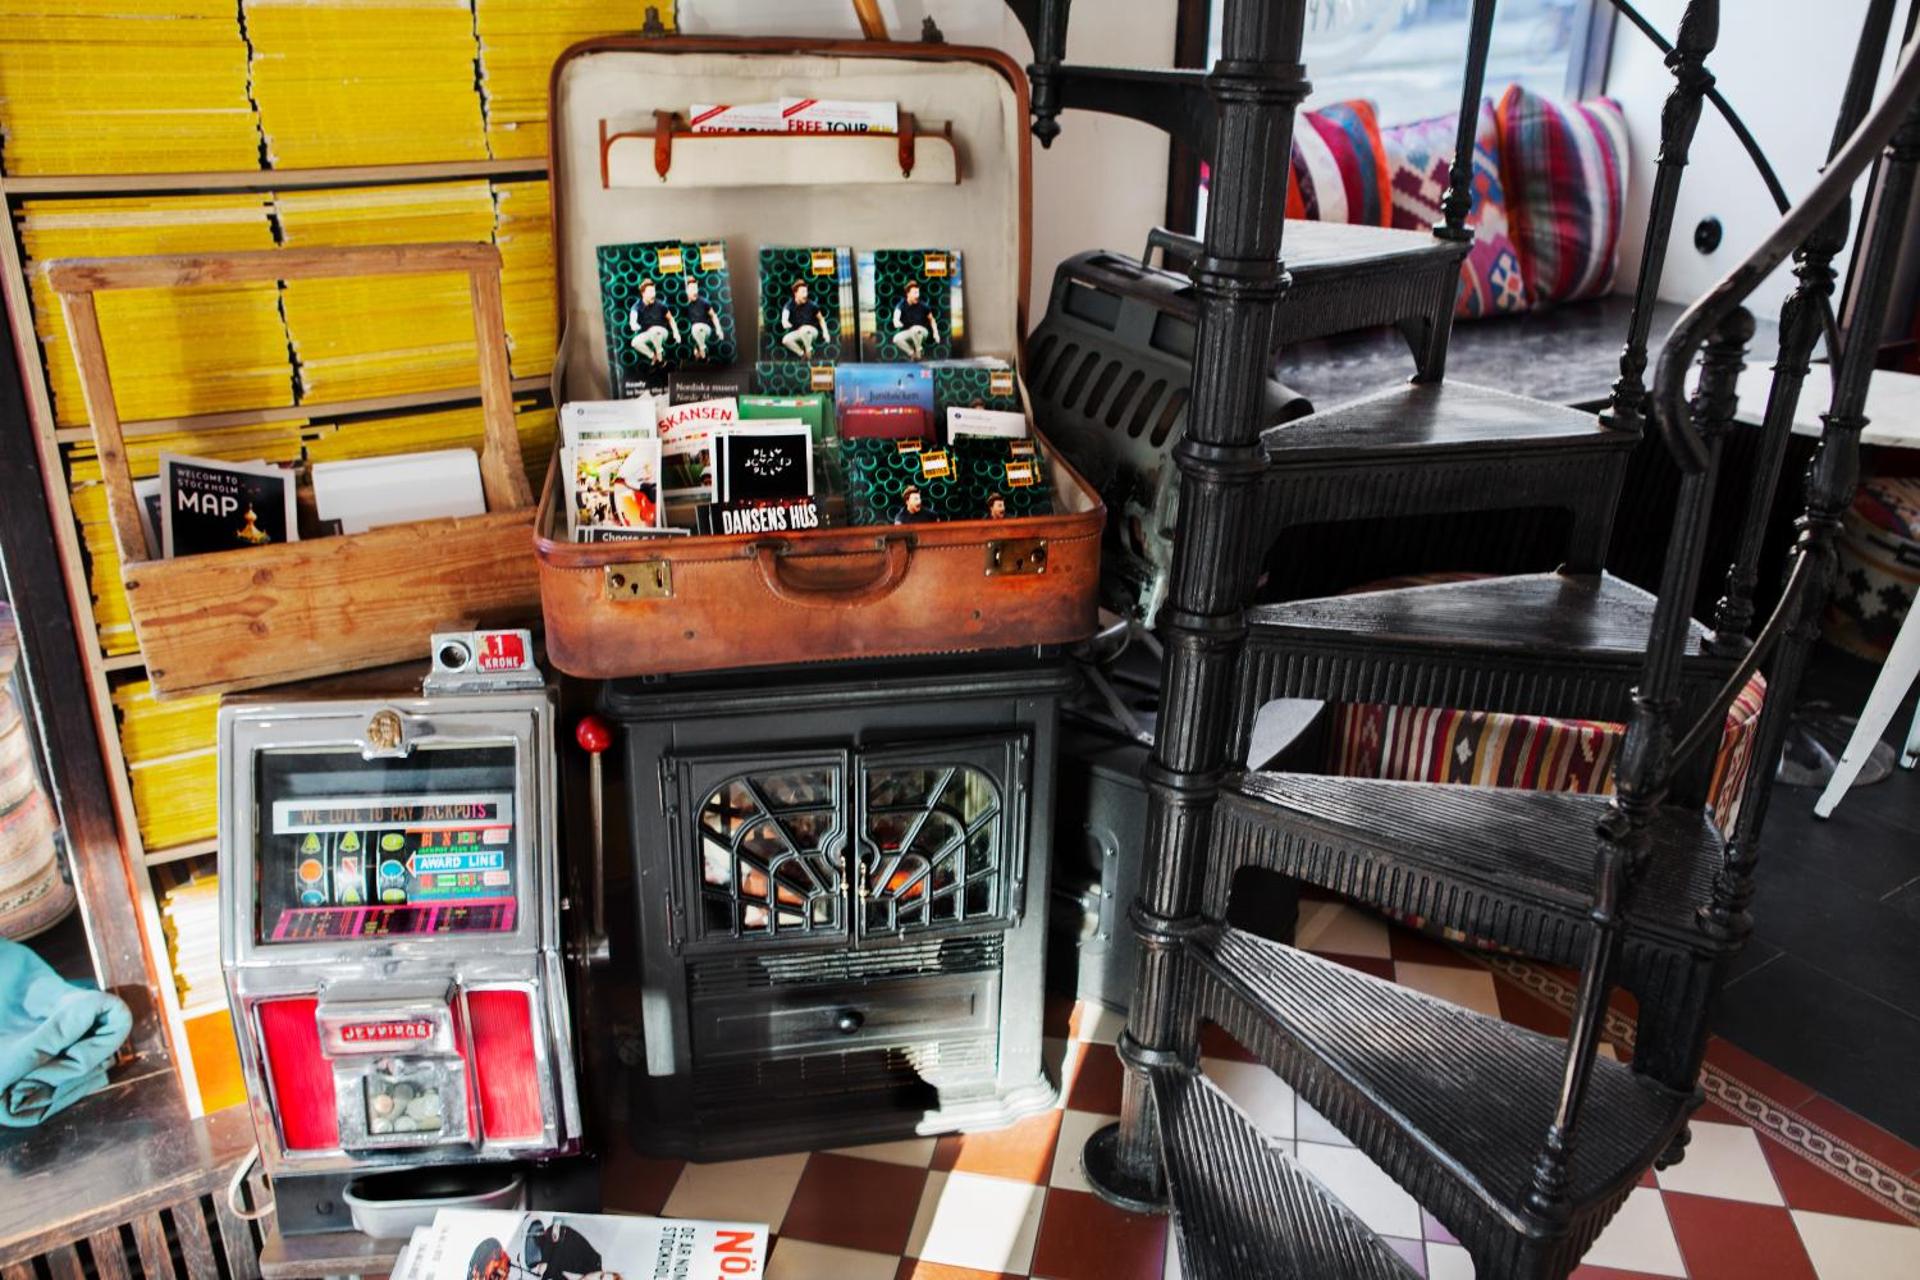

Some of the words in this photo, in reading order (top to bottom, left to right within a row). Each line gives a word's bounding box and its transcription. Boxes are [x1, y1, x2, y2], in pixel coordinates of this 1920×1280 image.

[788, 119, 822, 132] FREE
[827, 121, 868, 132] TOUR
[676, 382, 710, 392] Nordiska
[712, 384, 738, 392] museet
[658, 407, 732, 433] SKANSEN
[177, 469, 222, 482] WELCOME
[226, 475, 238, 485] TO
[177, 478, 239, 494] STOCKHOLM
[177, 488, 239, 518] MAP
[722, 506, 788, 535] DANSENS
[789, 503, 819, 530] HUS
[485, 656, 519, 668] KRONE
[302, 809, 322, 824] WE
[329, 808, 361, 823] LOVE
[369, 808, 384, 822] TO
[391, 806, 414, 821] PAY
[421, 803, 487, 820] JACKPOTS
[420, 856, 461, 870] AWARD
[469, 853, 497, 867] LINE
